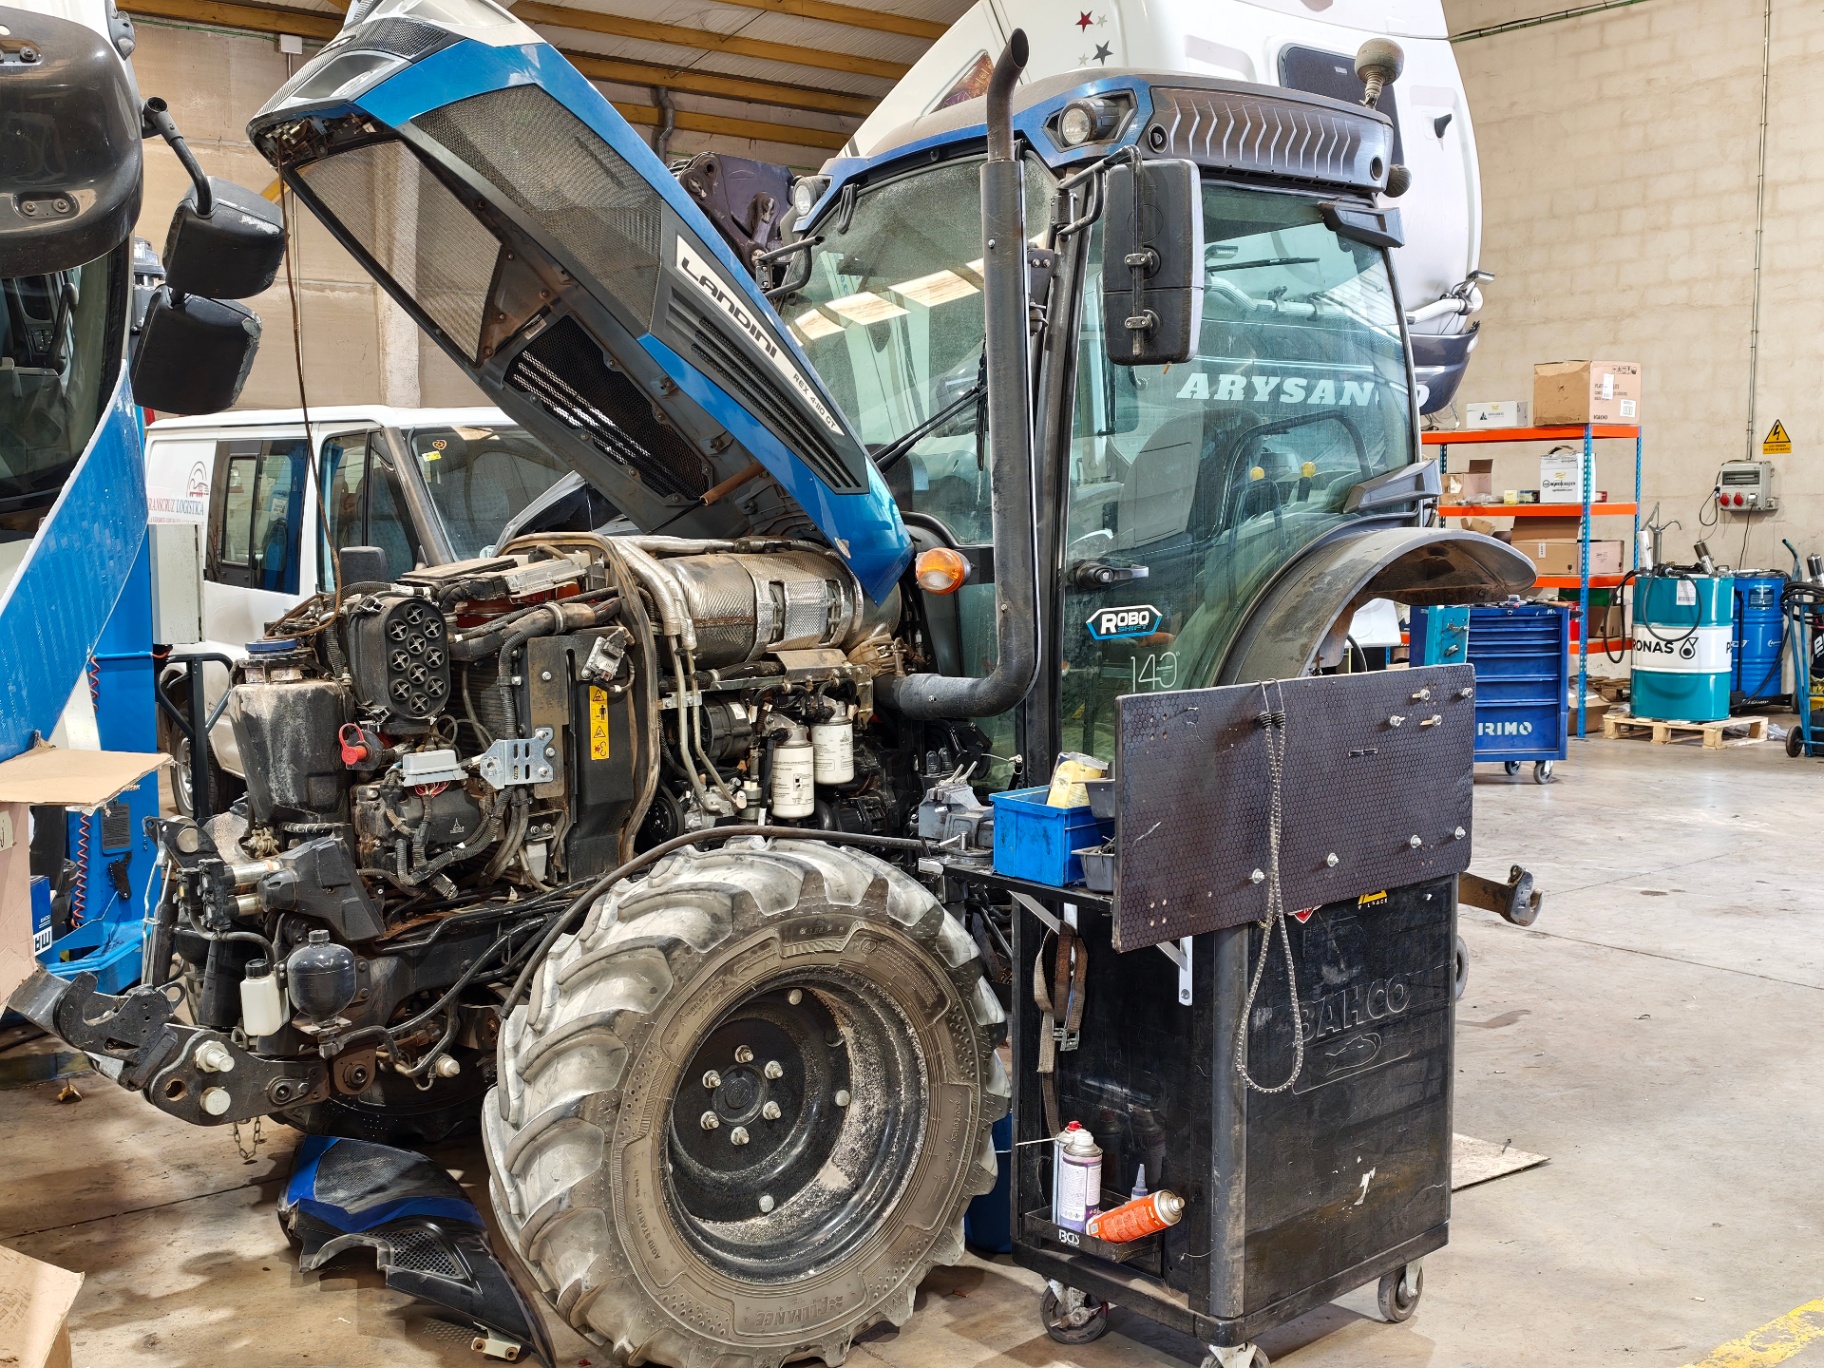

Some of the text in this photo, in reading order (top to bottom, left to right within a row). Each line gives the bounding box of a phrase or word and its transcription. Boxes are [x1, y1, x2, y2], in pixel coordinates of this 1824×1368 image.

[681, 256, 778, 359] LANDINI
[793, 373, 810, 395] REX
[825, 416, 837, 428] GT
[1176, 372, 1430, 408] ARYSAN
[147, 497, 176, 513] RANSCRUZ
[1100, 610, 1150, 635] ROBO
[1477, 721, 1533, 736] IRIMO
[1058, 1229, 1080, 1245] BGS
